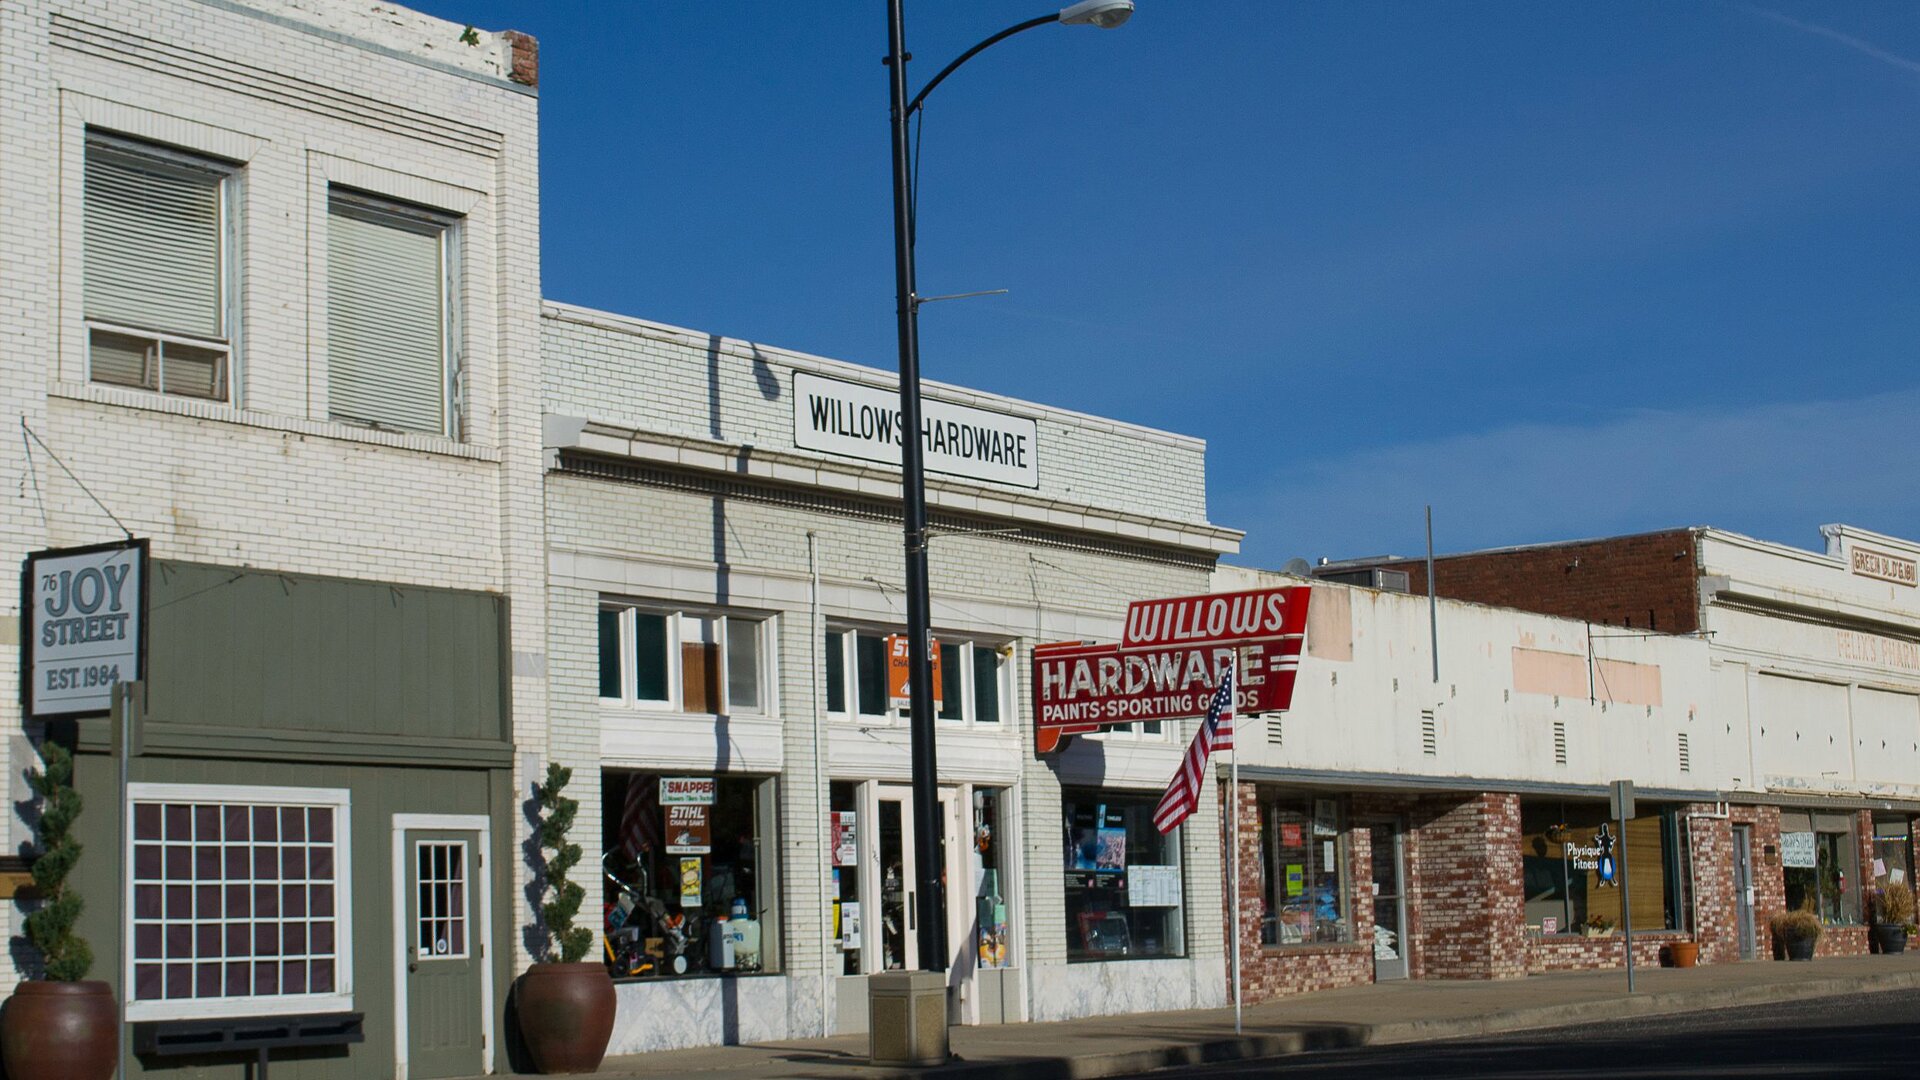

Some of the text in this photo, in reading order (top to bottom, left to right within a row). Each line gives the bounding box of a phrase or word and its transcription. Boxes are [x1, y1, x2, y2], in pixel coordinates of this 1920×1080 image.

[921, 416, 1027, 469] HARDWARE
[44, 563, 130, 617] JOY
[41, 613, 129, 647] STREET
[1128, 593, 1286, 643] WILLOWS
[46, 664, 119, 690] EST. 1984
[1041, 645, 1265, 701] HARDWARE
[1198, 690, 1259, 710] GDS
[668, 781, 715, 793] SNAPPER
[670, 806, 705, 819] STIHL
[1567, 842, 1600, 858] Physique
[1573, 856, 1598, 870] Fitness
